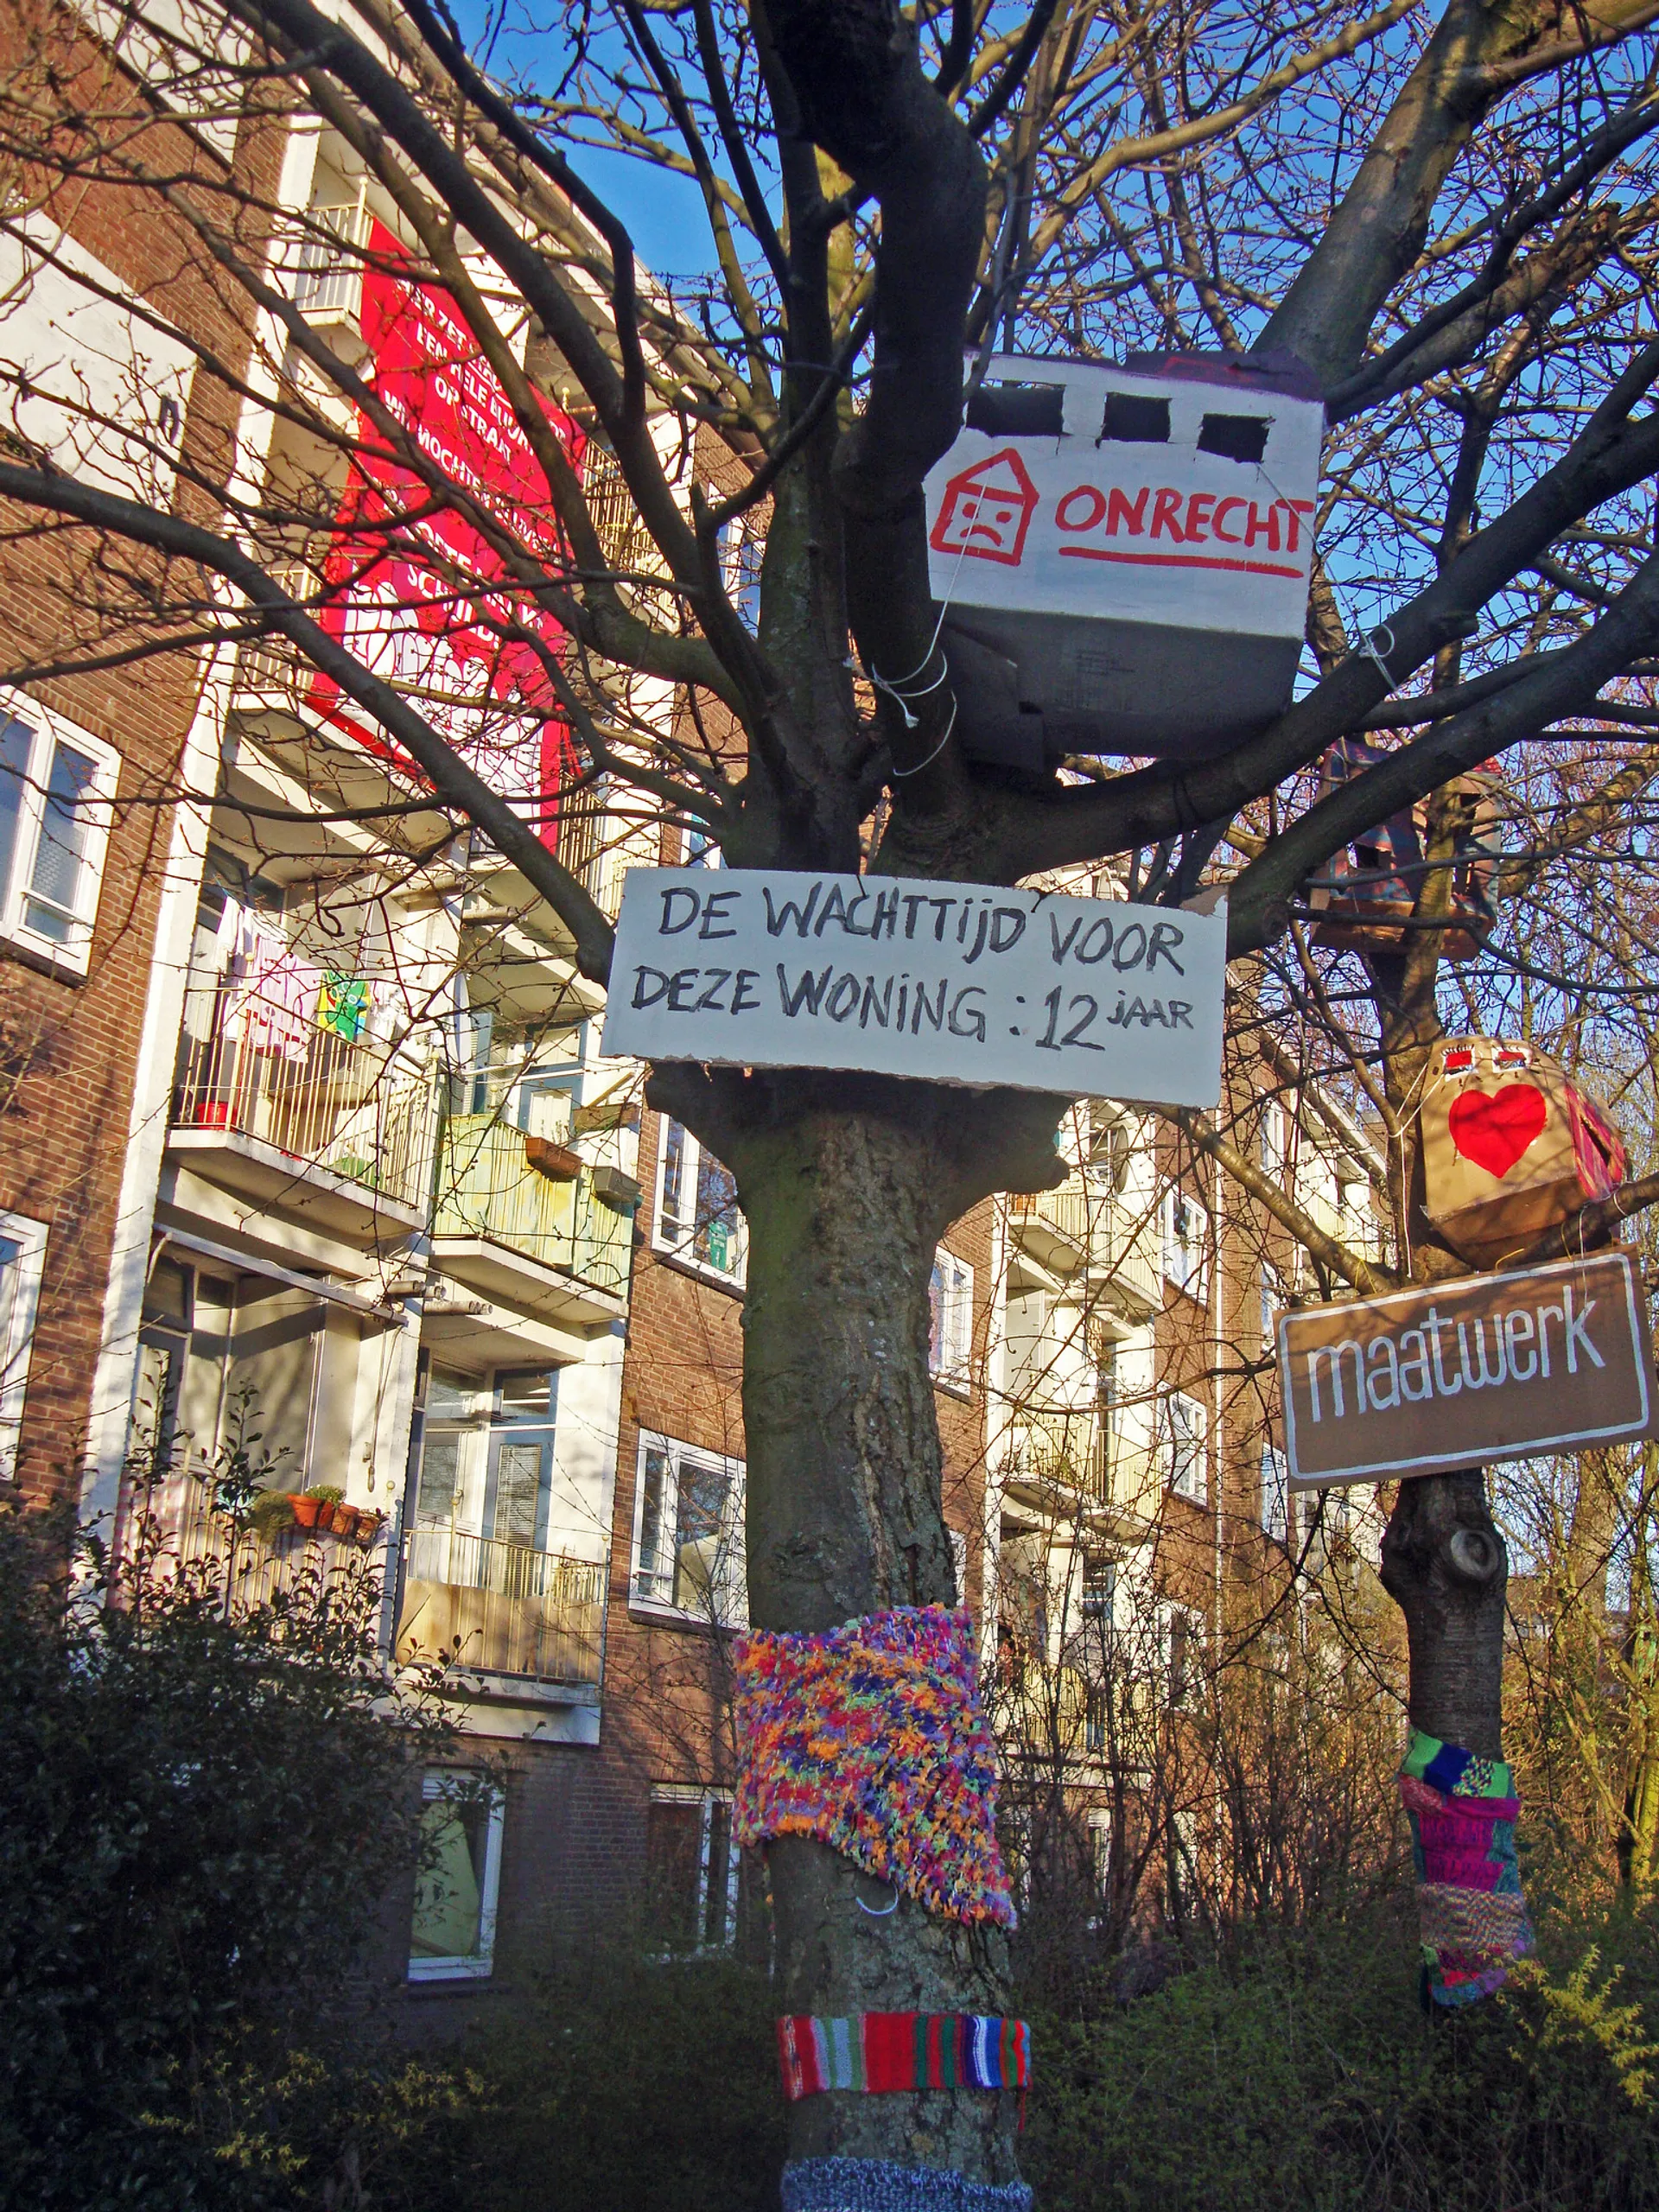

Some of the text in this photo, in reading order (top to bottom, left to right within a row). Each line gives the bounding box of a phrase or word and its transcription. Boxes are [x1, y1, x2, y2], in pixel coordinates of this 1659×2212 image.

[416, 322, 448, 361] EEN
[435, 376, 512, 466] OP STRAAT
[1055, 485, 1314, 552] ONRECHT
[658, 886, 742, 940] DE
[1049, 911, 1185, 976] VOOR
[631, 964, 761, 1016] DEZE
[1306, 1284, 1606, 1423] maatwerk
